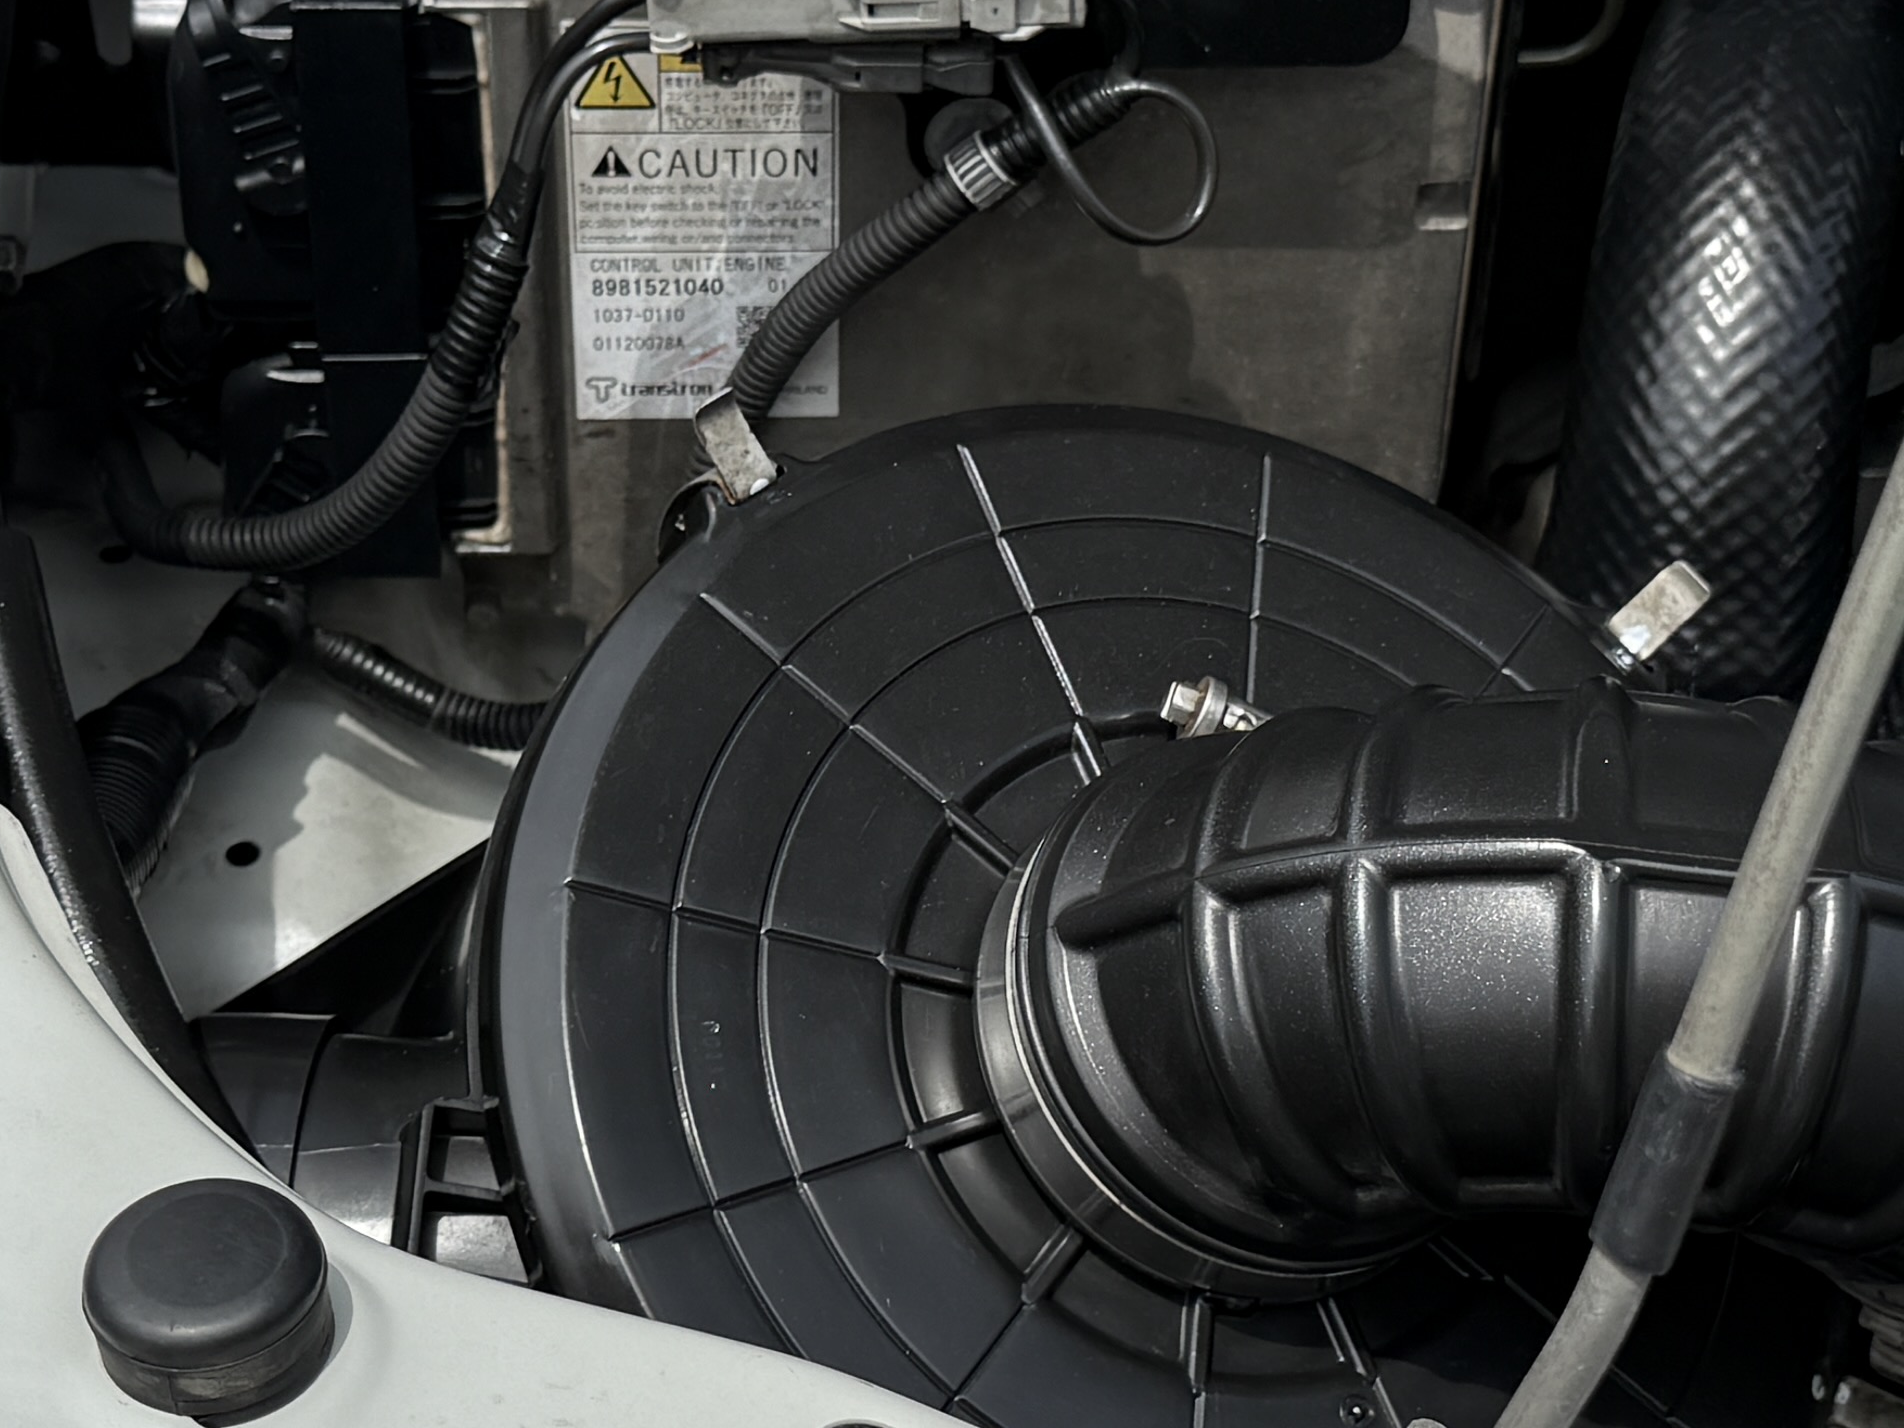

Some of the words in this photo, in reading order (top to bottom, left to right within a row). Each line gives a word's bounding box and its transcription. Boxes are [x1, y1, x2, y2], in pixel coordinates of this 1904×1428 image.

[638, 147, 819, 179] CAUTION
[590, 258, 662, 273] CONTROL
[592, 278, 724, 296] 8981521040
